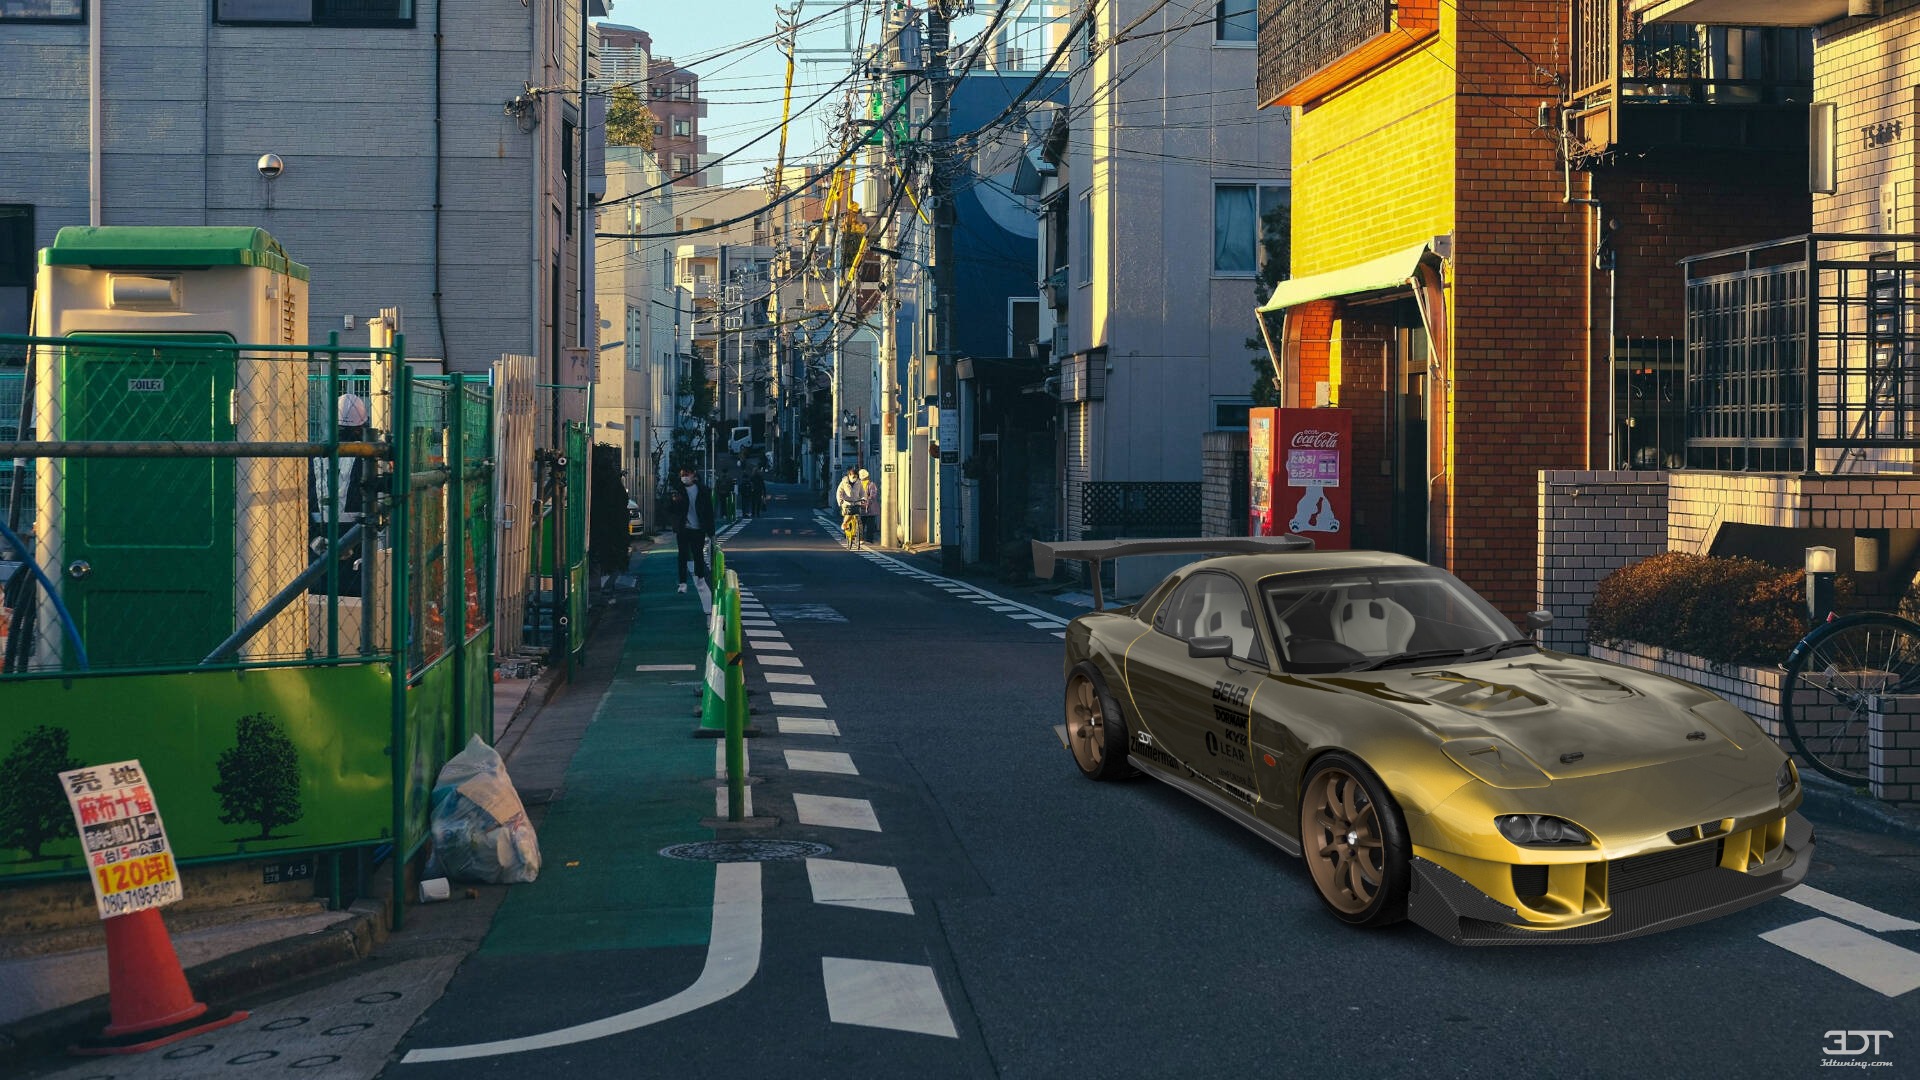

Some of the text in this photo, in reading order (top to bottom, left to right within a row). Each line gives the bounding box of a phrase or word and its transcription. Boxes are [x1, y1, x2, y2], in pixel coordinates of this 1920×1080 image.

[1291, 431, 1339, 448] Coca-Cola
[1212, 680, 1249, 707] BEHR
[1220, 742, 1245, 762] LEAR
[77, 785, 153, 825] 麻布十番
[99, 854, 171, 893] 120坪!
[287, 864, 307, 877] 4-9
